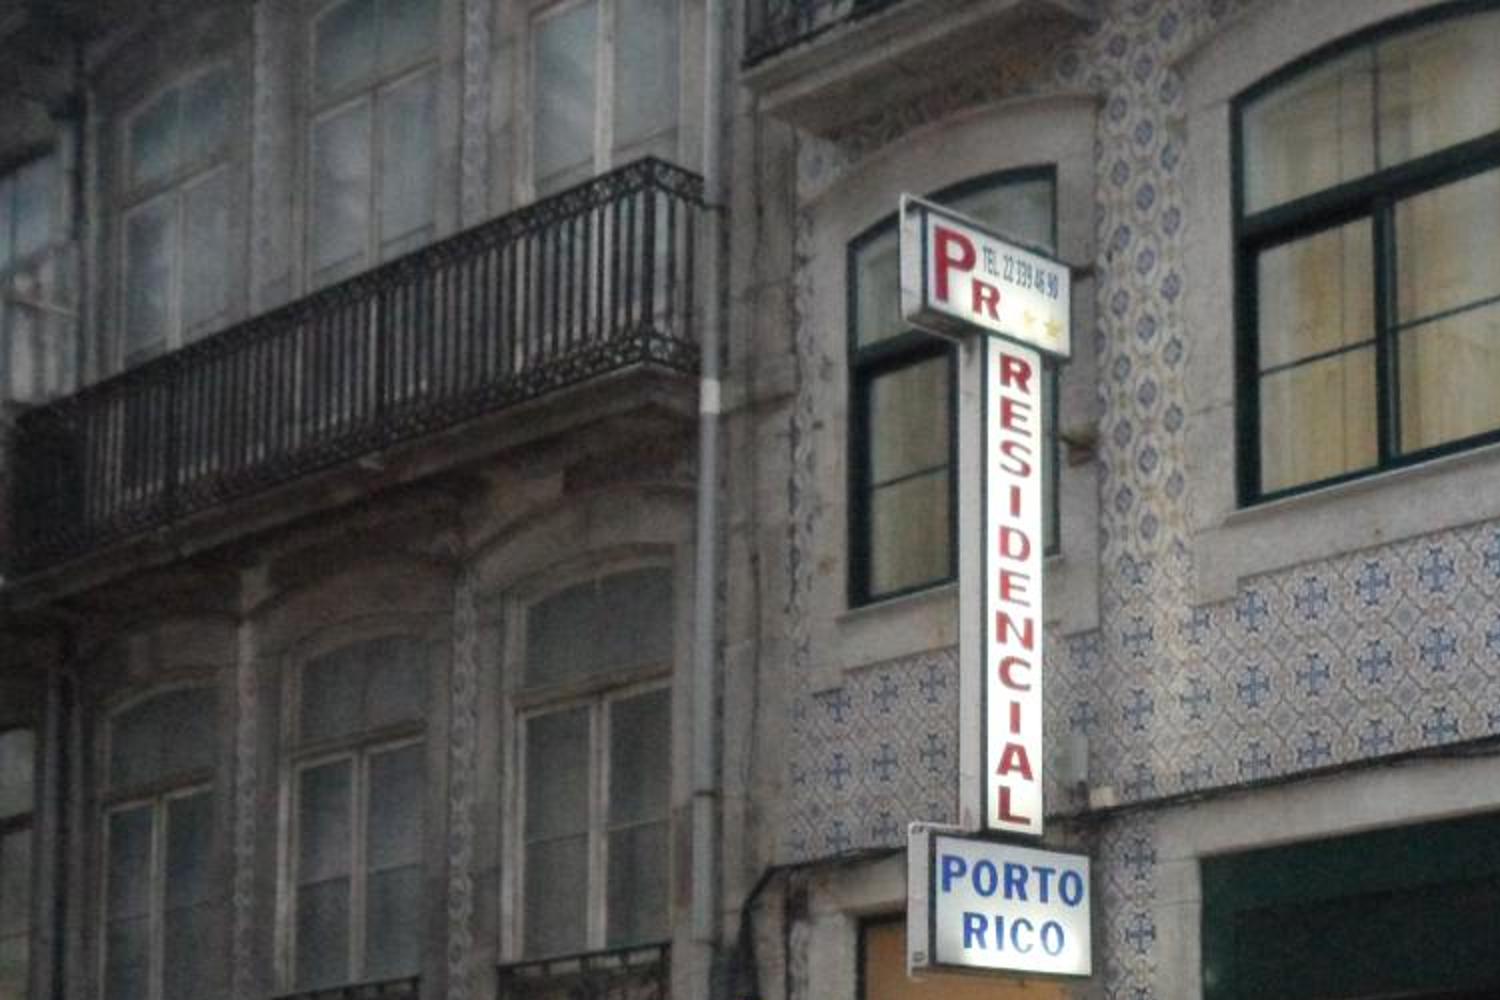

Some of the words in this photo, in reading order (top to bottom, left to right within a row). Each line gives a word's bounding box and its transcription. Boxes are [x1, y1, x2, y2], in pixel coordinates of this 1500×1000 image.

[995, 352, 1035, 826] RESIDENCIAL
[941, 854, 1085, 908] PORTO
[963, 911, 1066, 957] RICO
